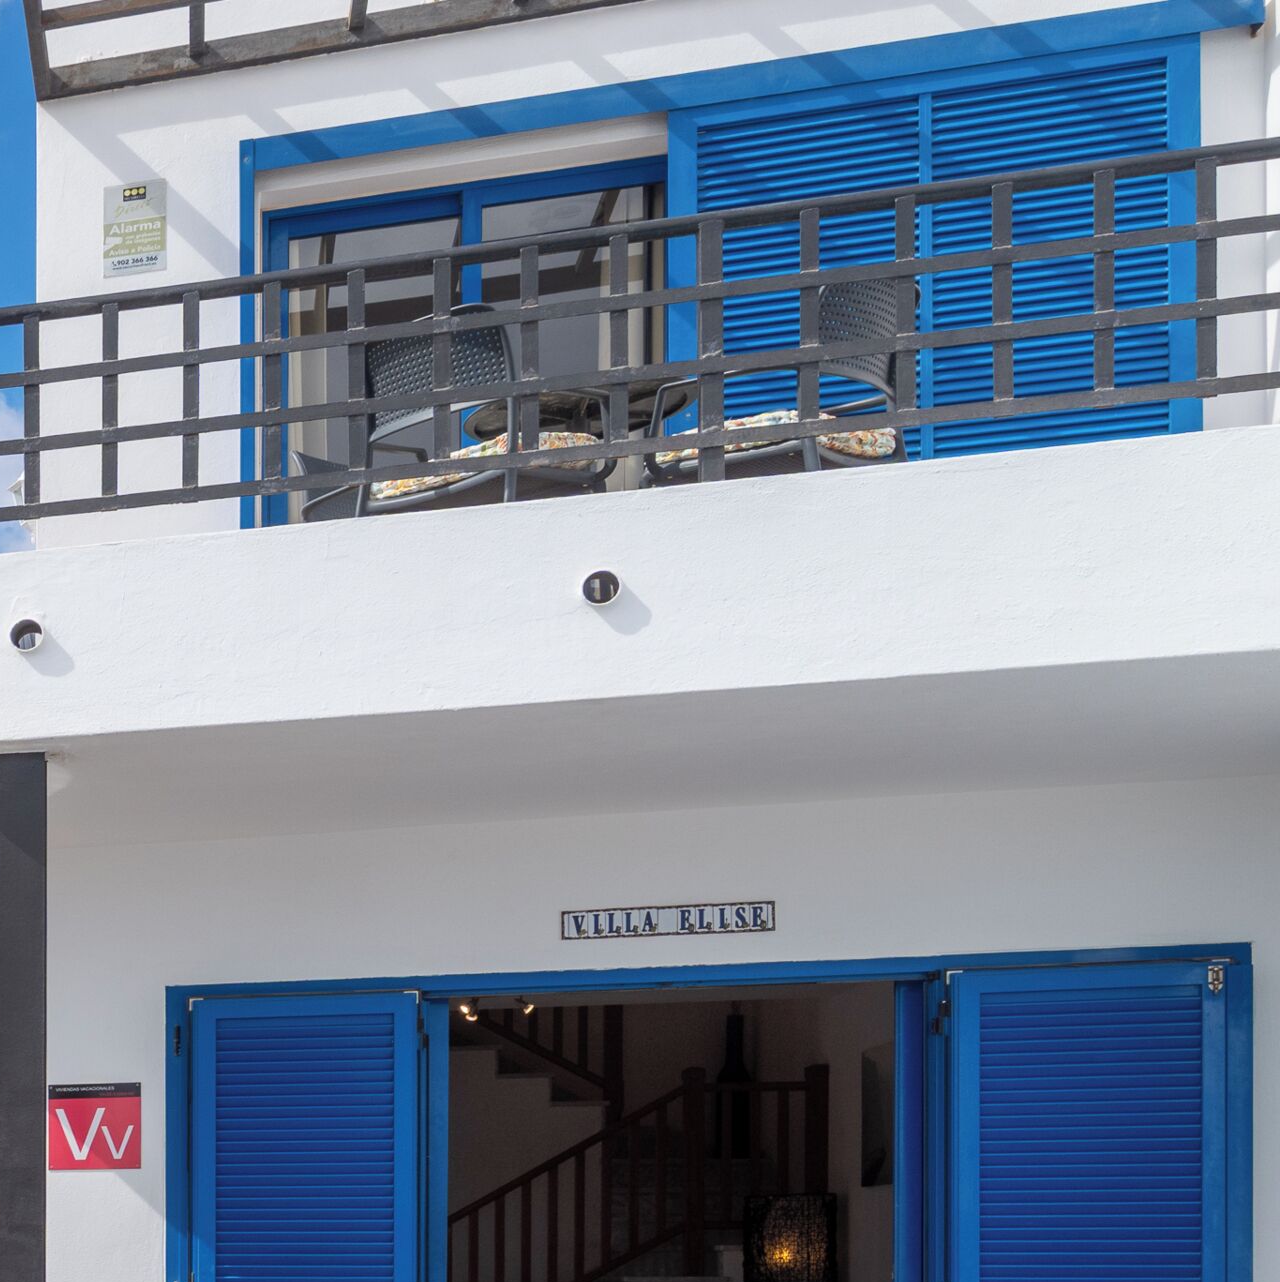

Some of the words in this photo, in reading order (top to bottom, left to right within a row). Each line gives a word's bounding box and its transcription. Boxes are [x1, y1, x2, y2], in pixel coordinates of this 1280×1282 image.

[109, 221, 161, 235] Alarma
[572, 911, 656, 936] VILLA
[679, 906, 766, 931] ELISE
[55, 1107, 134, 1161] Vv
